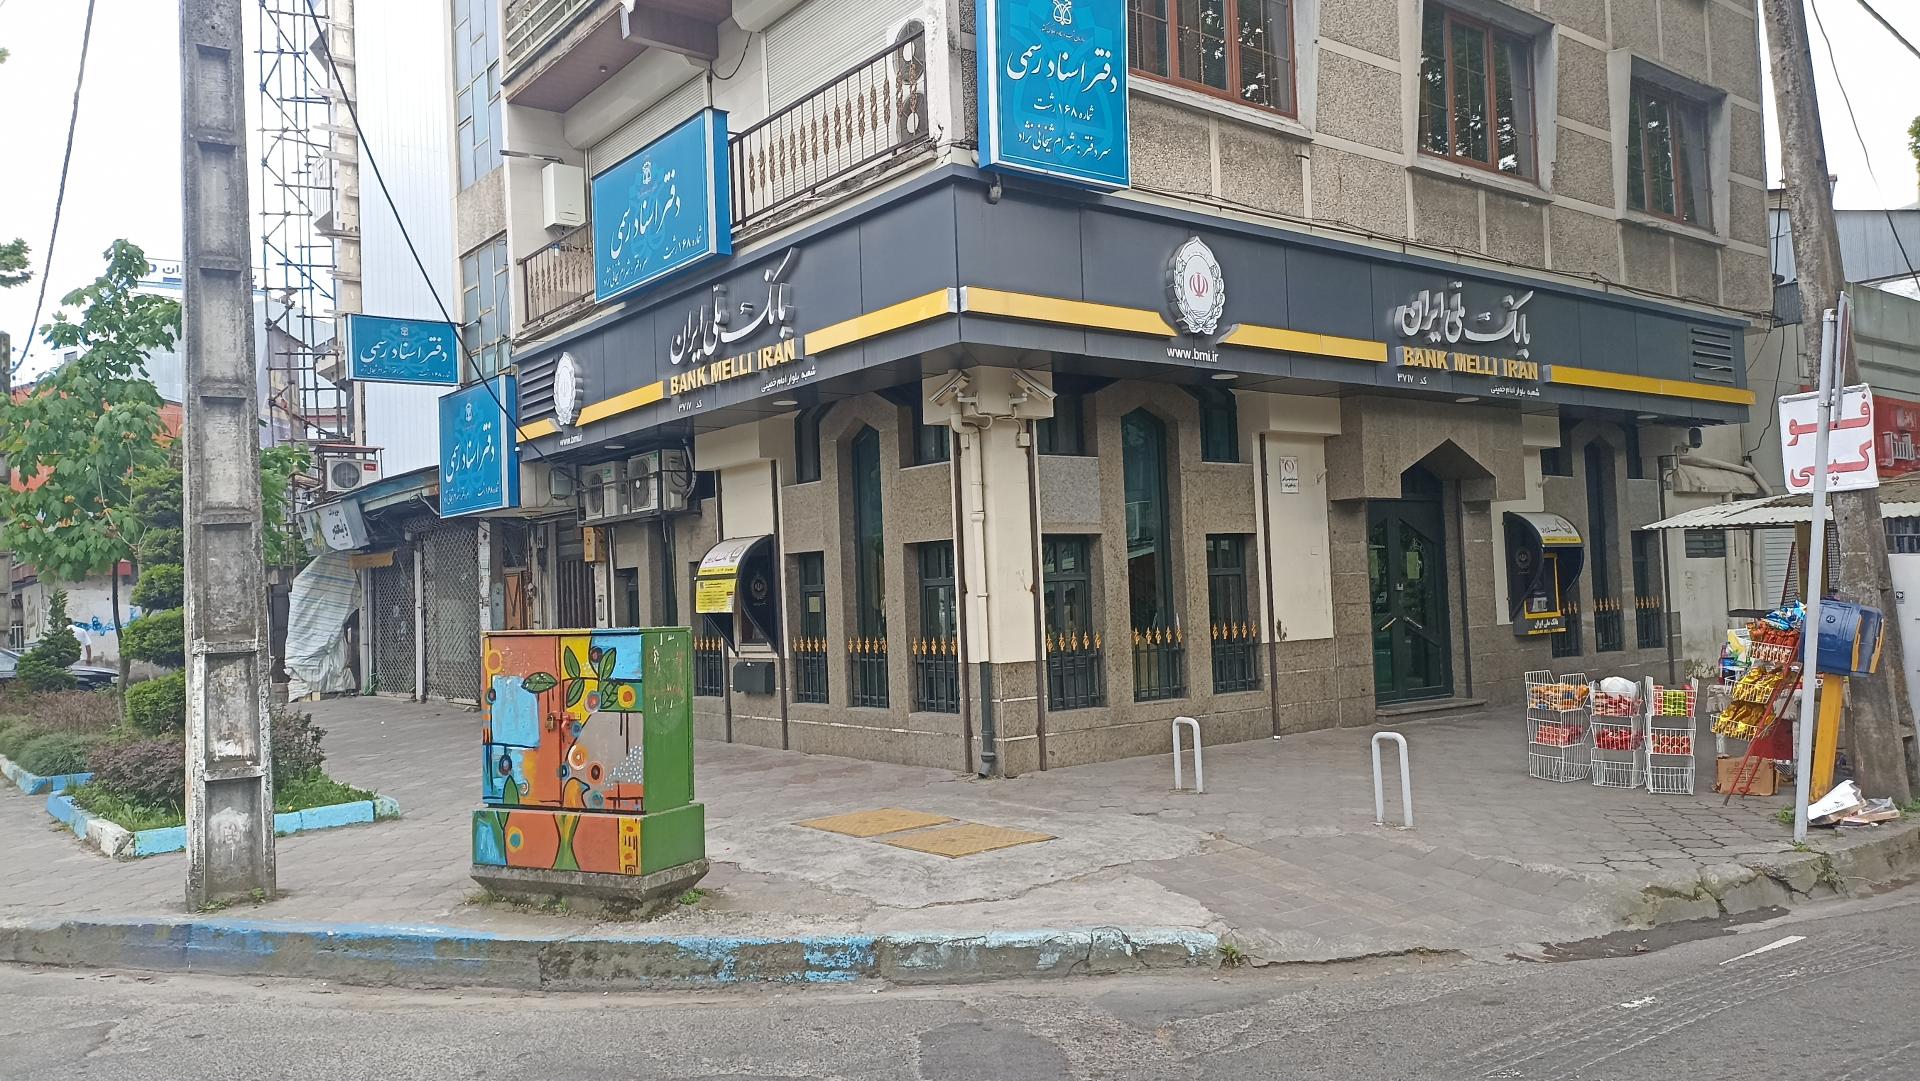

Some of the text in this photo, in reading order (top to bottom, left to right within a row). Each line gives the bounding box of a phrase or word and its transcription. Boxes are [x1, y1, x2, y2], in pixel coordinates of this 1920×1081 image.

[1007, 43, 1118, 93] دفتر اسناد رسمی
[1033, 93, 1094, 121] شماره ۱۶۸ رشت
[1053, 132, 1076, 154] شهرام
[609, 168, 681, 259] دفتر اسناد رسمی
[663, 236, 678, 260] رشت
[678, 237, 692, 252] ۱۶۸
[670, 247, 795, 365] بانک ملی ایران
[1399, 281, 1534, 360] بانک ملی ایران
[360, 336, 448, 364] دفتر اسناد رسمی
[1166, 346, 1219, 363] www.bmi.ir
[1402, 345, 1539, 381] BANK MELLI IRAN
[670, 338, 797, 396] BANK MELLI IRAN
[760, 364, 817, 393] شعبه بلوار امام خمینی
[1419, 376, 1427, 385] کد
[1490, 384, 1506, 395] خمینی
[1526, 387, 1540, 397] شعبه
[695, 399, 703, 409] کد
[445, 422, 495, 483] دفتر اسناد رسمی
[1790, 440, 1872, 487] کپی
